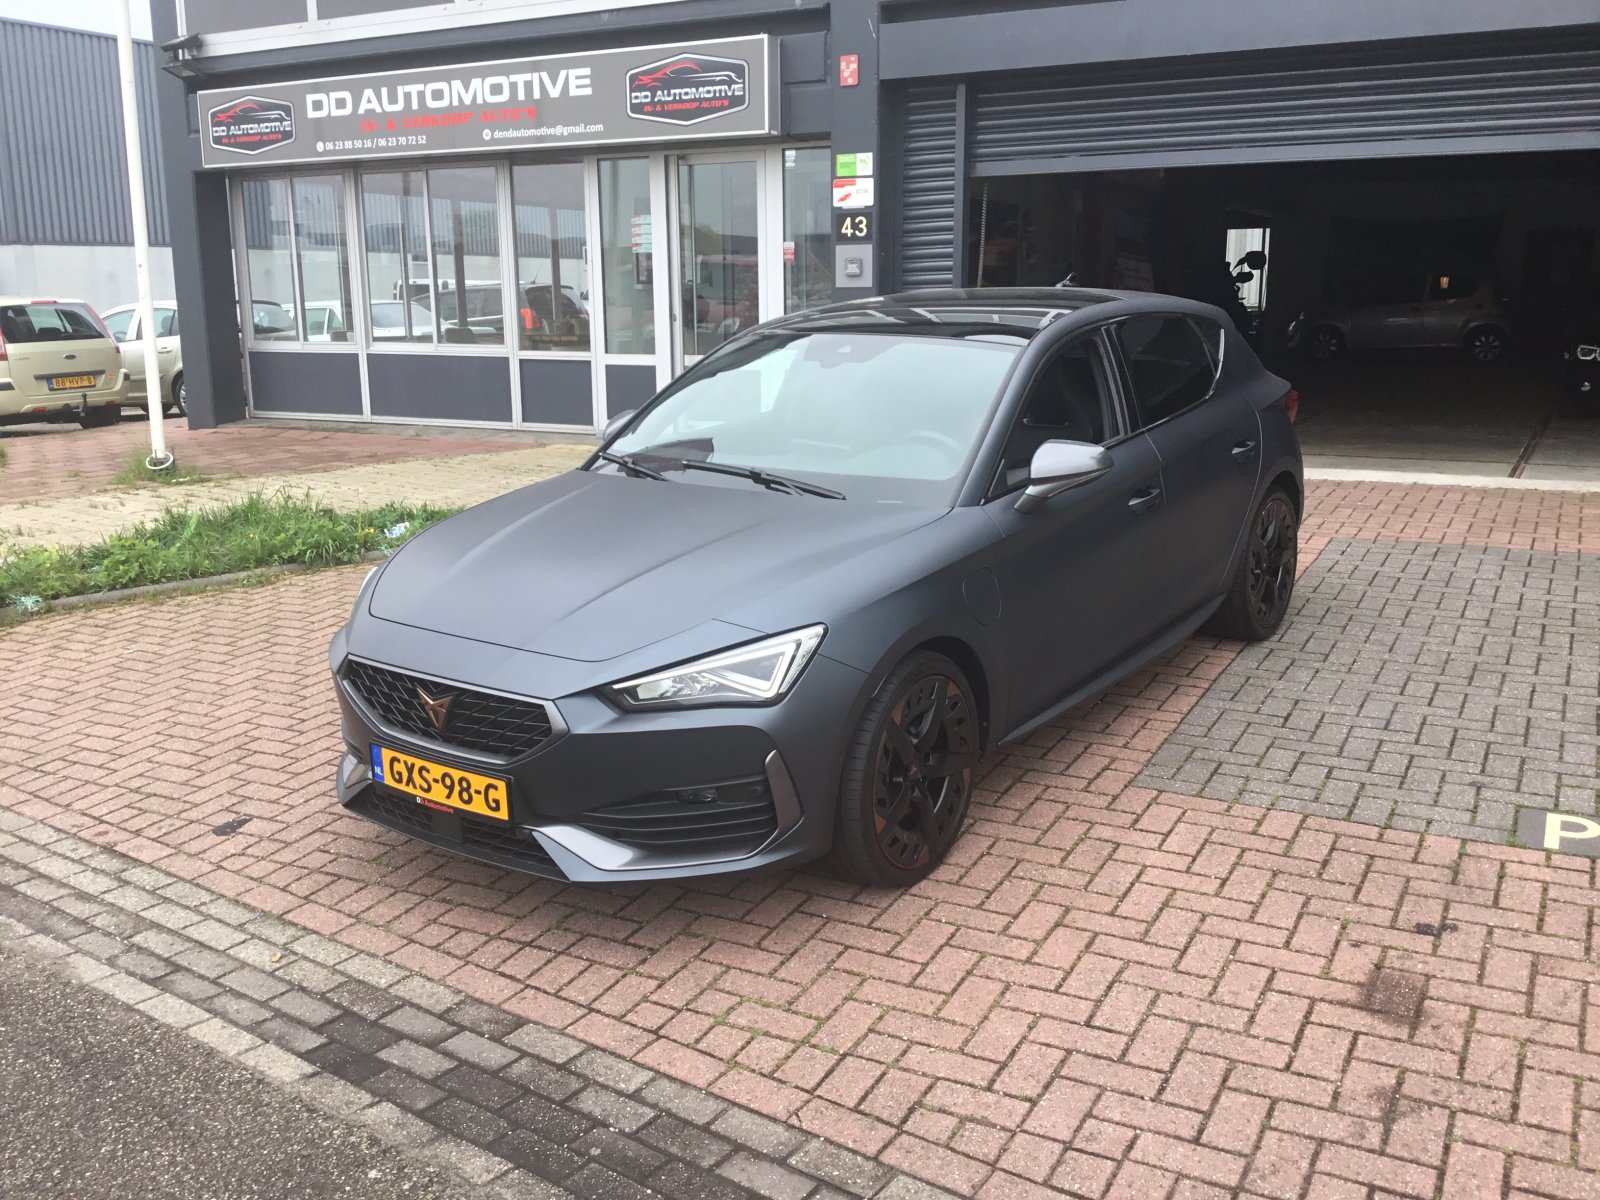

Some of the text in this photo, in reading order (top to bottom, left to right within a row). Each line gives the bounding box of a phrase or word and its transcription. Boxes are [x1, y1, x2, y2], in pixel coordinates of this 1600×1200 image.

[306, 67, 592, 119] DD AUTOMOTIVE
[631, 84, 744, 104] DD AUTOMOTIVE
[402, 111, 474, 129] VERKOOP
[479, 106, 537, 122] AUTO'S
[212, 120, 292, 137] DD AUTOMOTIVE
[493, 123, 604, 140] dendautomotive@gmail.com
[325, 141, 334, 151] 06
[335, 140, 344, 150] 23
[363, 138, 372, 148] 16
[378, 137, 387, 147] 06
[388, 137, 397, 146] 23
[397, 136, 407, 146] 70
[407, 135, 417, 145] 72
[417, 134, 427, 144] 52
[841, 216, 868, 238] 43
[374, 765, 383, 777] NL
[389, 756, 501, 812] GXS-98-G
[1543, 812, 1600, 850] P
